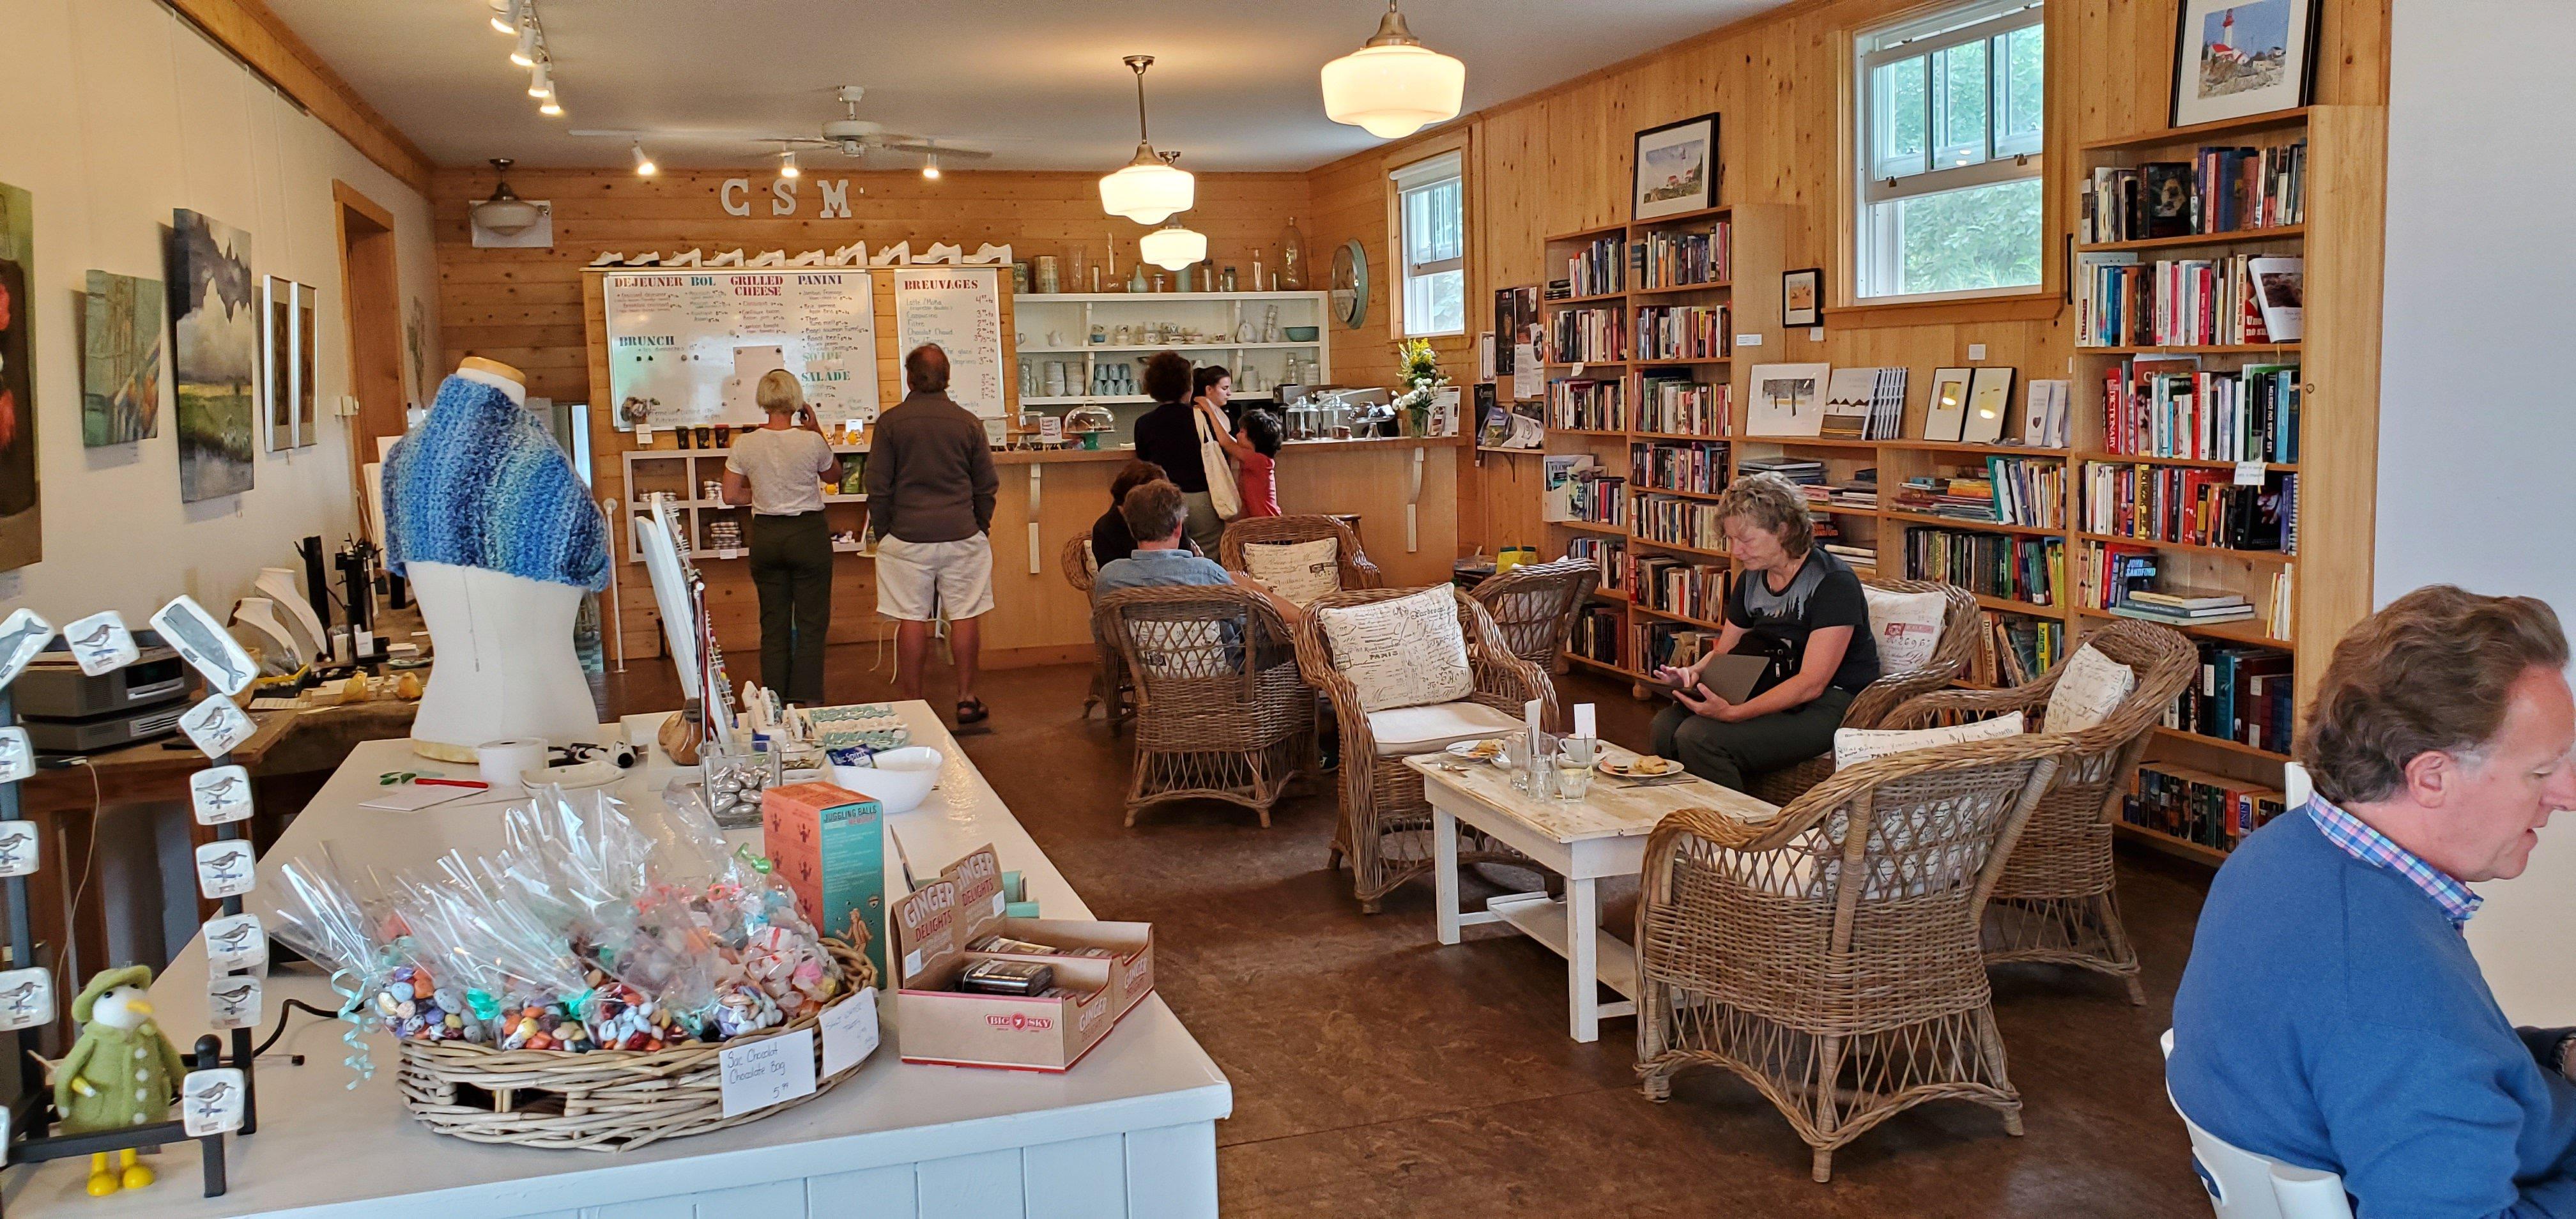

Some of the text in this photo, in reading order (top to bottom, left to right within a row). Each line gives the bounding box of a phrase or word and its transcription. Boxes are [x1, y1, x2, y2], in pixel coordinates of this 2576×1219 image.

[615, 277, 684, 288] DEJEUNER
[691, 276, 716, 286] BOL
[730, 275, 783, 286] GRILLED
[798, 275, 842, 285] PANINI
[905, 280, 978, 290] BREUVAGES
[734, 286, 781, 296] CHEESE
[619, 335, 675, 347] BRUNCH
[801, 371, 850, 381] SALADE
[2267, 411, 2273, 421] DU
[2128, 559, 2143, 568] JOHN
[2126, 567, 2156, 576] SANDFORD
[1369, 650, 1398, 660] PARIS
[824, 809, 856, 823] JUGGLING
[857, 805, 877, 816] BALLS
[962, 878, 994, 907] DELIGHTS
[903, 880, 955, 928] GINGER
[916, 910, 953, 942] DELIGHTS
[1125, 956, 1147, 989] GINGER
[1080, 996, 1107, 1032] GINGER
[990, 1016, 1050, 1028] BIG SKY
[728, 1041, 778, 1068] Sac Chocolat
[730, 1061, 786, 1084] Chocolate Bag
